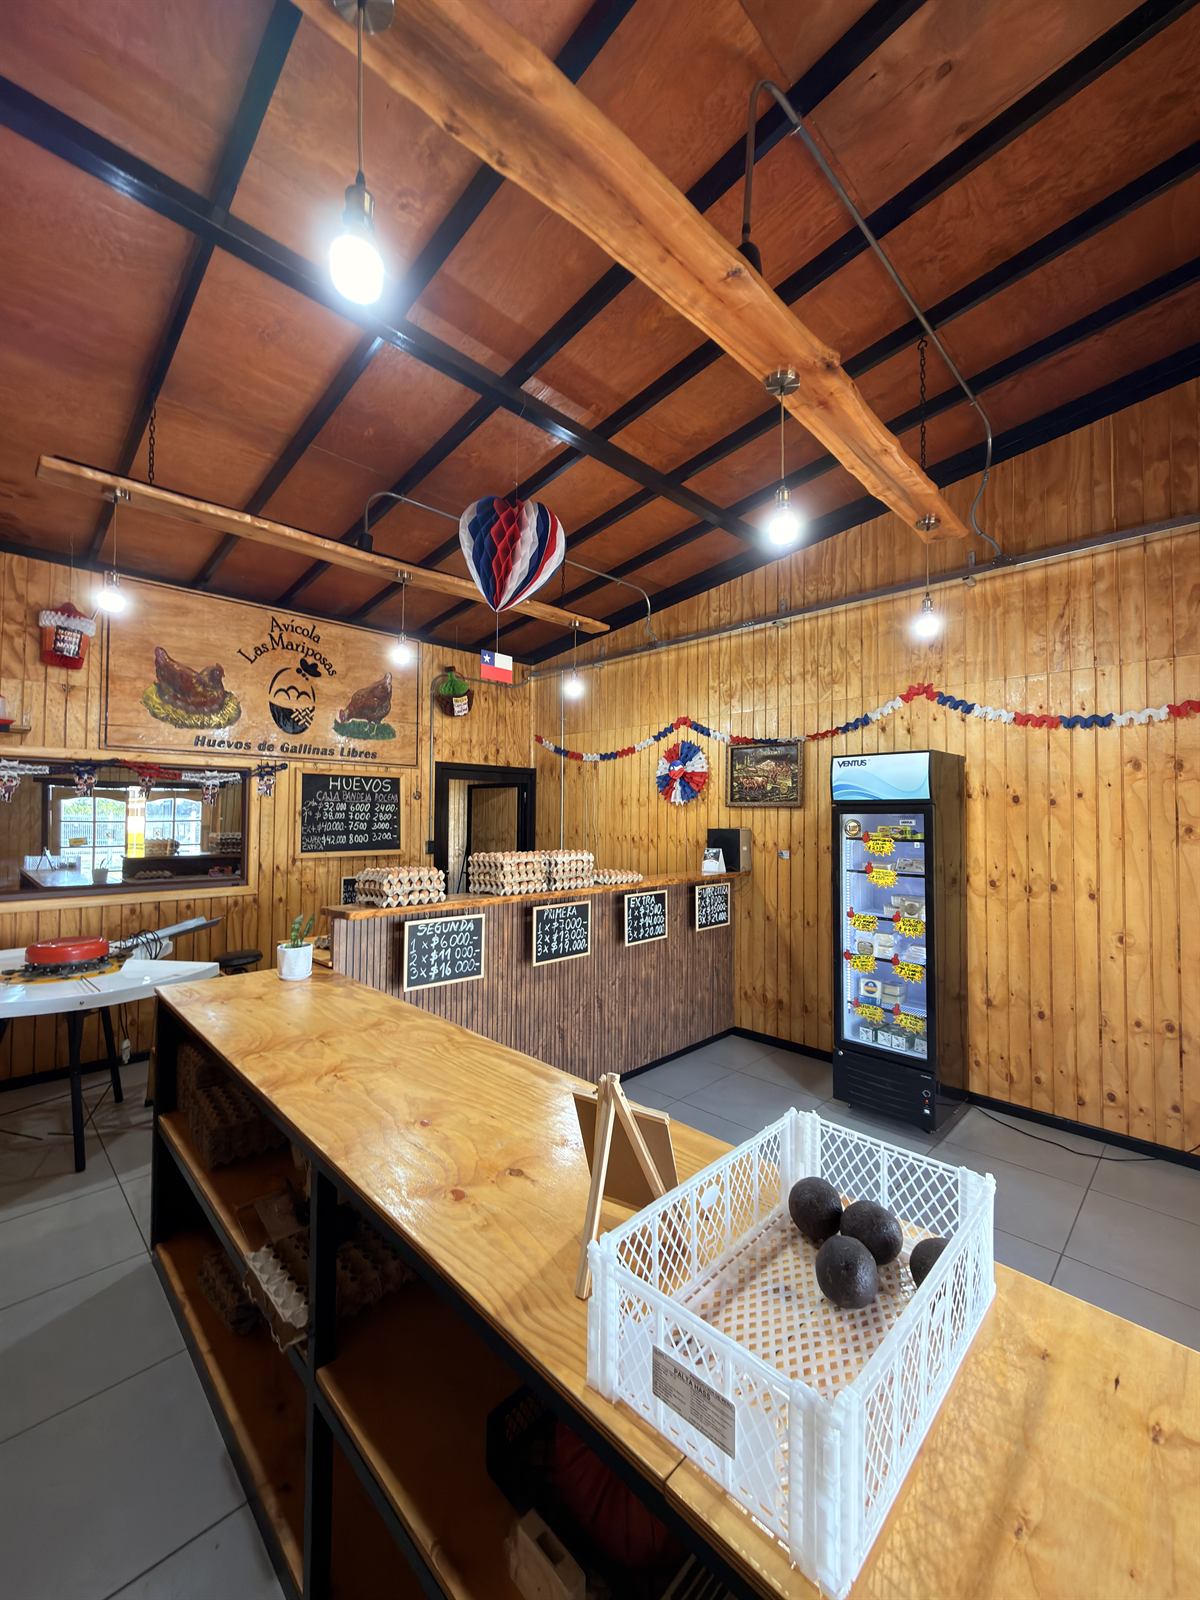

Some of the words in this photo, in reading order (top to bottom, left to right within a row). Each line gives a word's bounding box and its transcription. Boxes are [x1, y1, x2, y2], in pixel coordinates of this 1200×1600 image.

[270, 615, 320, 644] Avícola
[236, 643, 269, 664] Las
[268, 632, 336, 676] Mariposas
[193, 735, 252, 751] Huevos
[257, 741, 275, 752] de
[280, 742, 335, 757] Gallinas
[339, 747, 378, 760] Libres
[837, 759, 867, 768] VENTUS
[329, 777, 392, 793] HUEVOS
[316, 791, 341, 802] CAJA
[350, 803, 371, 812] 6000
[348, 812, 371, 821] 7000
[348, 821, 368, 831] 7500
[348, 833, 369, 845] 8000
[630, 895, 656, 908] EXTRA
[543, 906, 577, 920] PRIMERA
[416, 920, 475, 936] SEGUNDA
[409, 938, 417, 954] 1
[409, 953, 418, 967] 2
[409, 966, 419, 980] 3
[673, 1366, 693, 1386] PALTA
